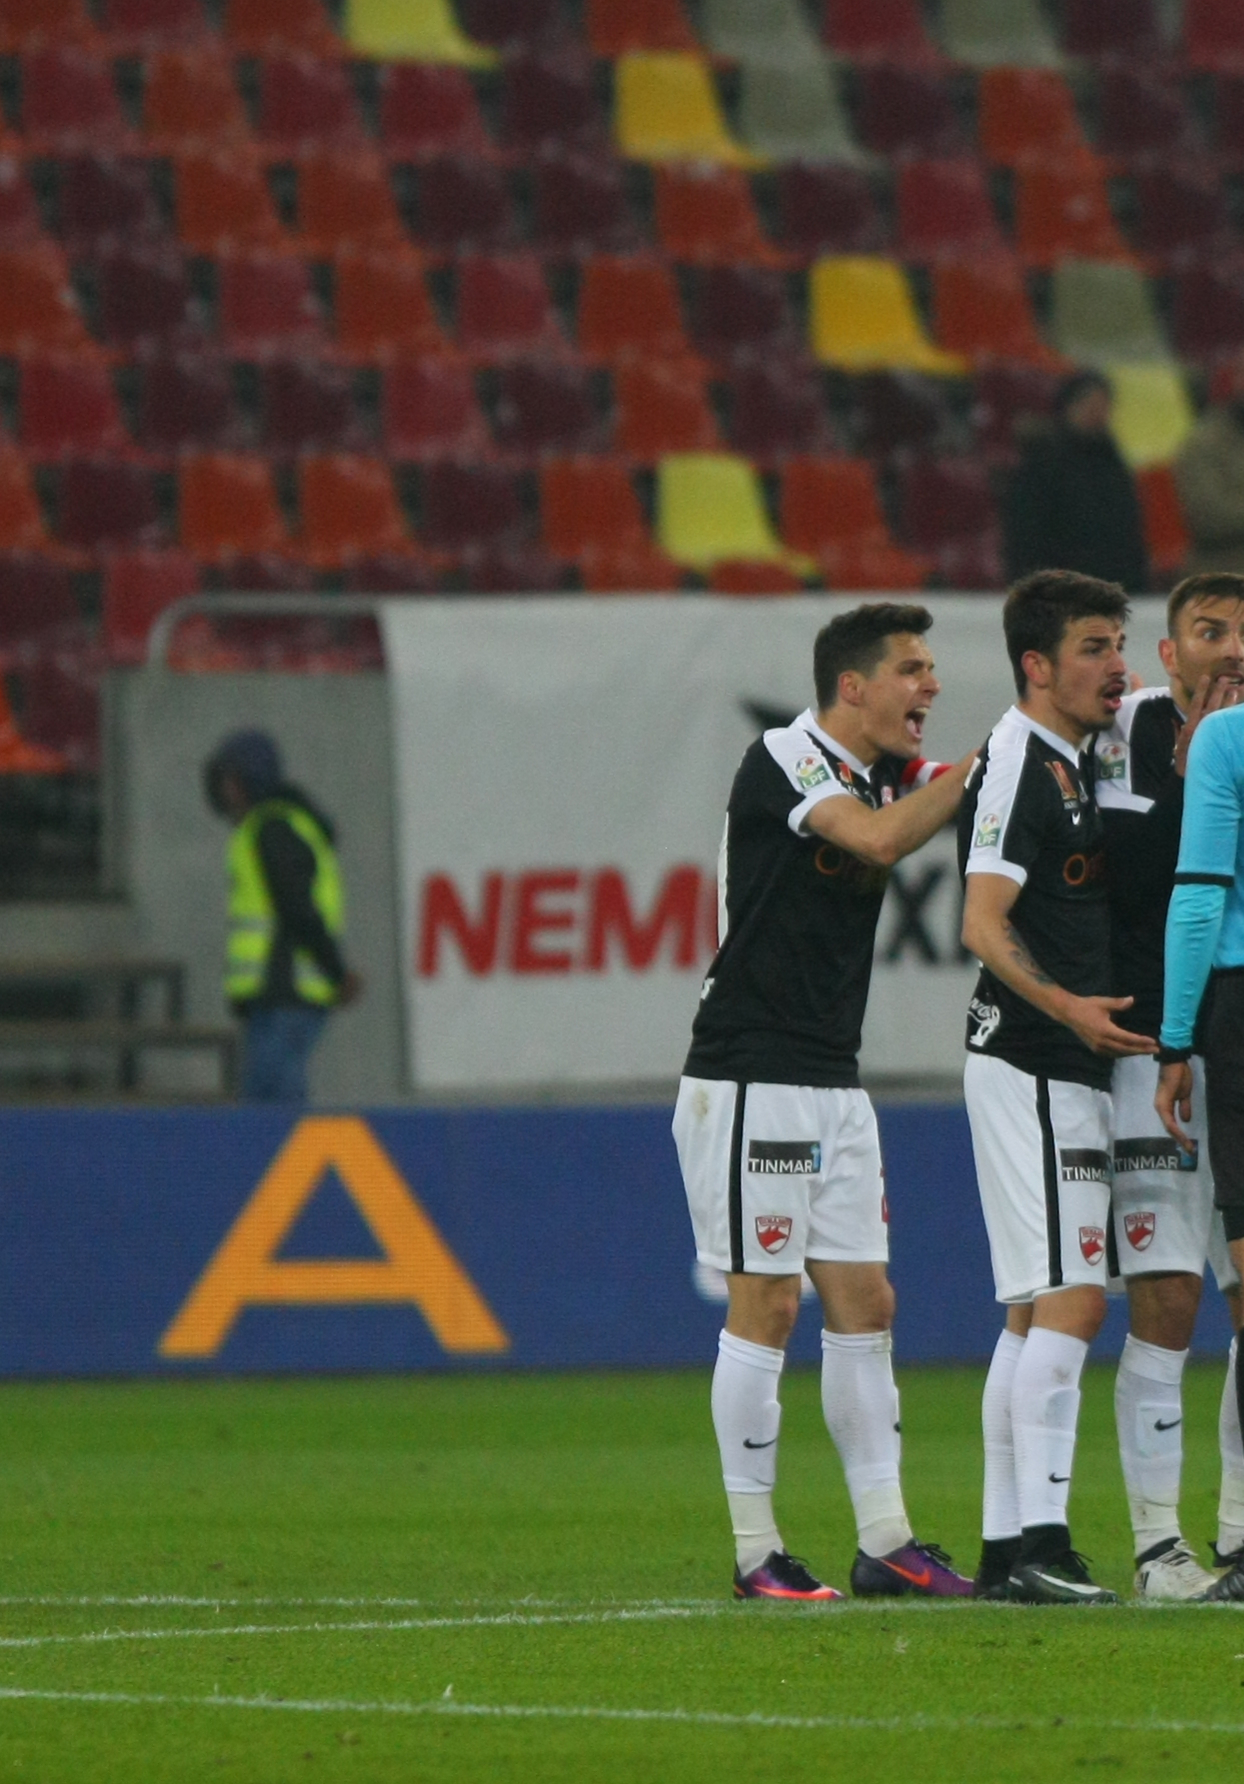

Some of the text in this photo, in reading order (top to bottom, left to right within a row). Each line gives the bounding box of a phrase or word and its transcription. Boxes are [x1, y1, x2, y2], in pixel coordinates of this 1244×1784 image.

[801, 770, 826, 788] LPF
[977, 833, 996, 846] LPF
[416, 864, 720, 978] NEM
[749, 1158, 812, 1173] TINMAR
[1115, 1156, 1178, 1170] TINMAR
[1063, 1166, 1105, 1180] TINM
[157, 1116, 510, 1356] A
